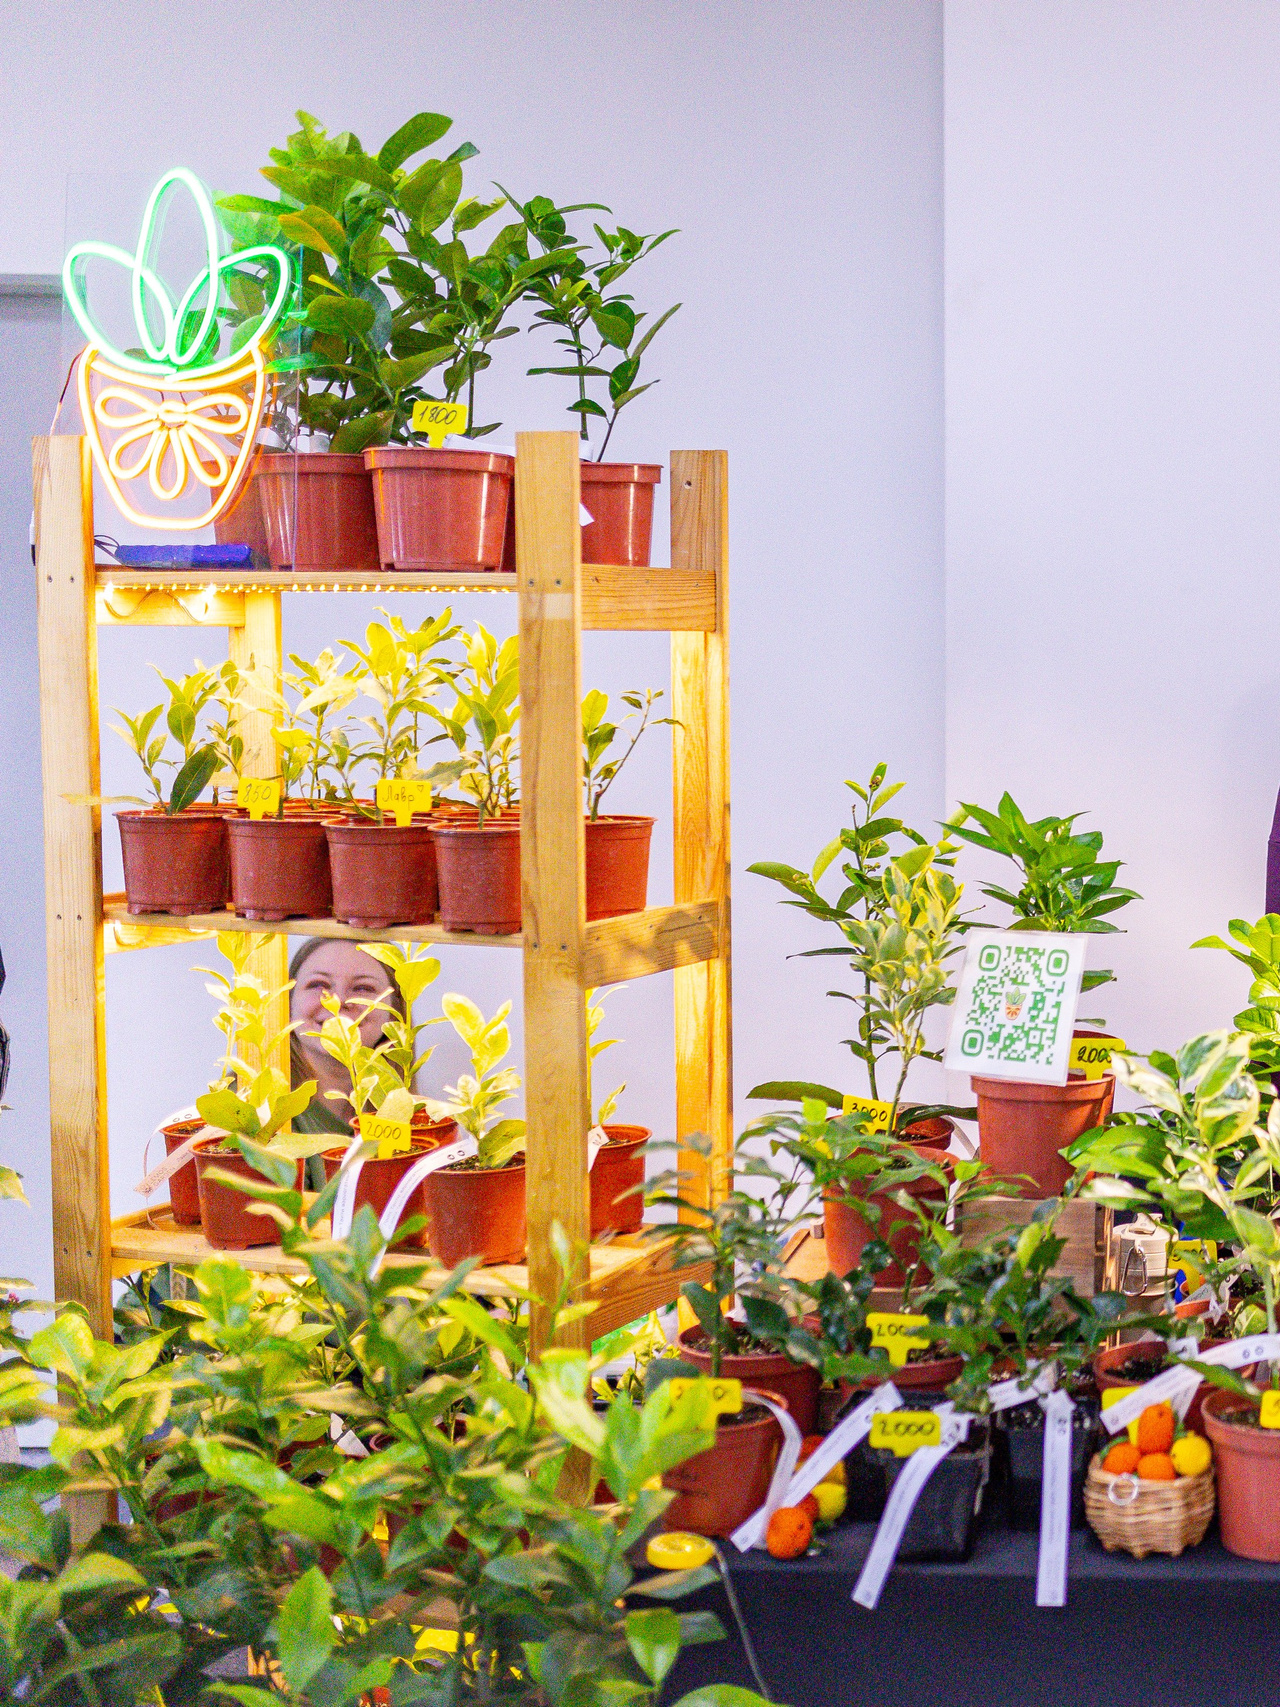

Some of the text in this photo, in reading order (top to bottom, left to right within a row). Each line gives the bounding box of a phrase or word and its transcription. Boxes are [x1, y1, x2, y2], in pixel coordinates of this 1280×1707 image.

[419, 405, 458, 425] 1800
[243, 783, 272, 804] 850
[382, 784, 415, 812] Лавр
[366, 1121, 402, 1140] 2000
[876, 1323, 907, 1337] 200
[880, 1420, 936, 1437] 2000
